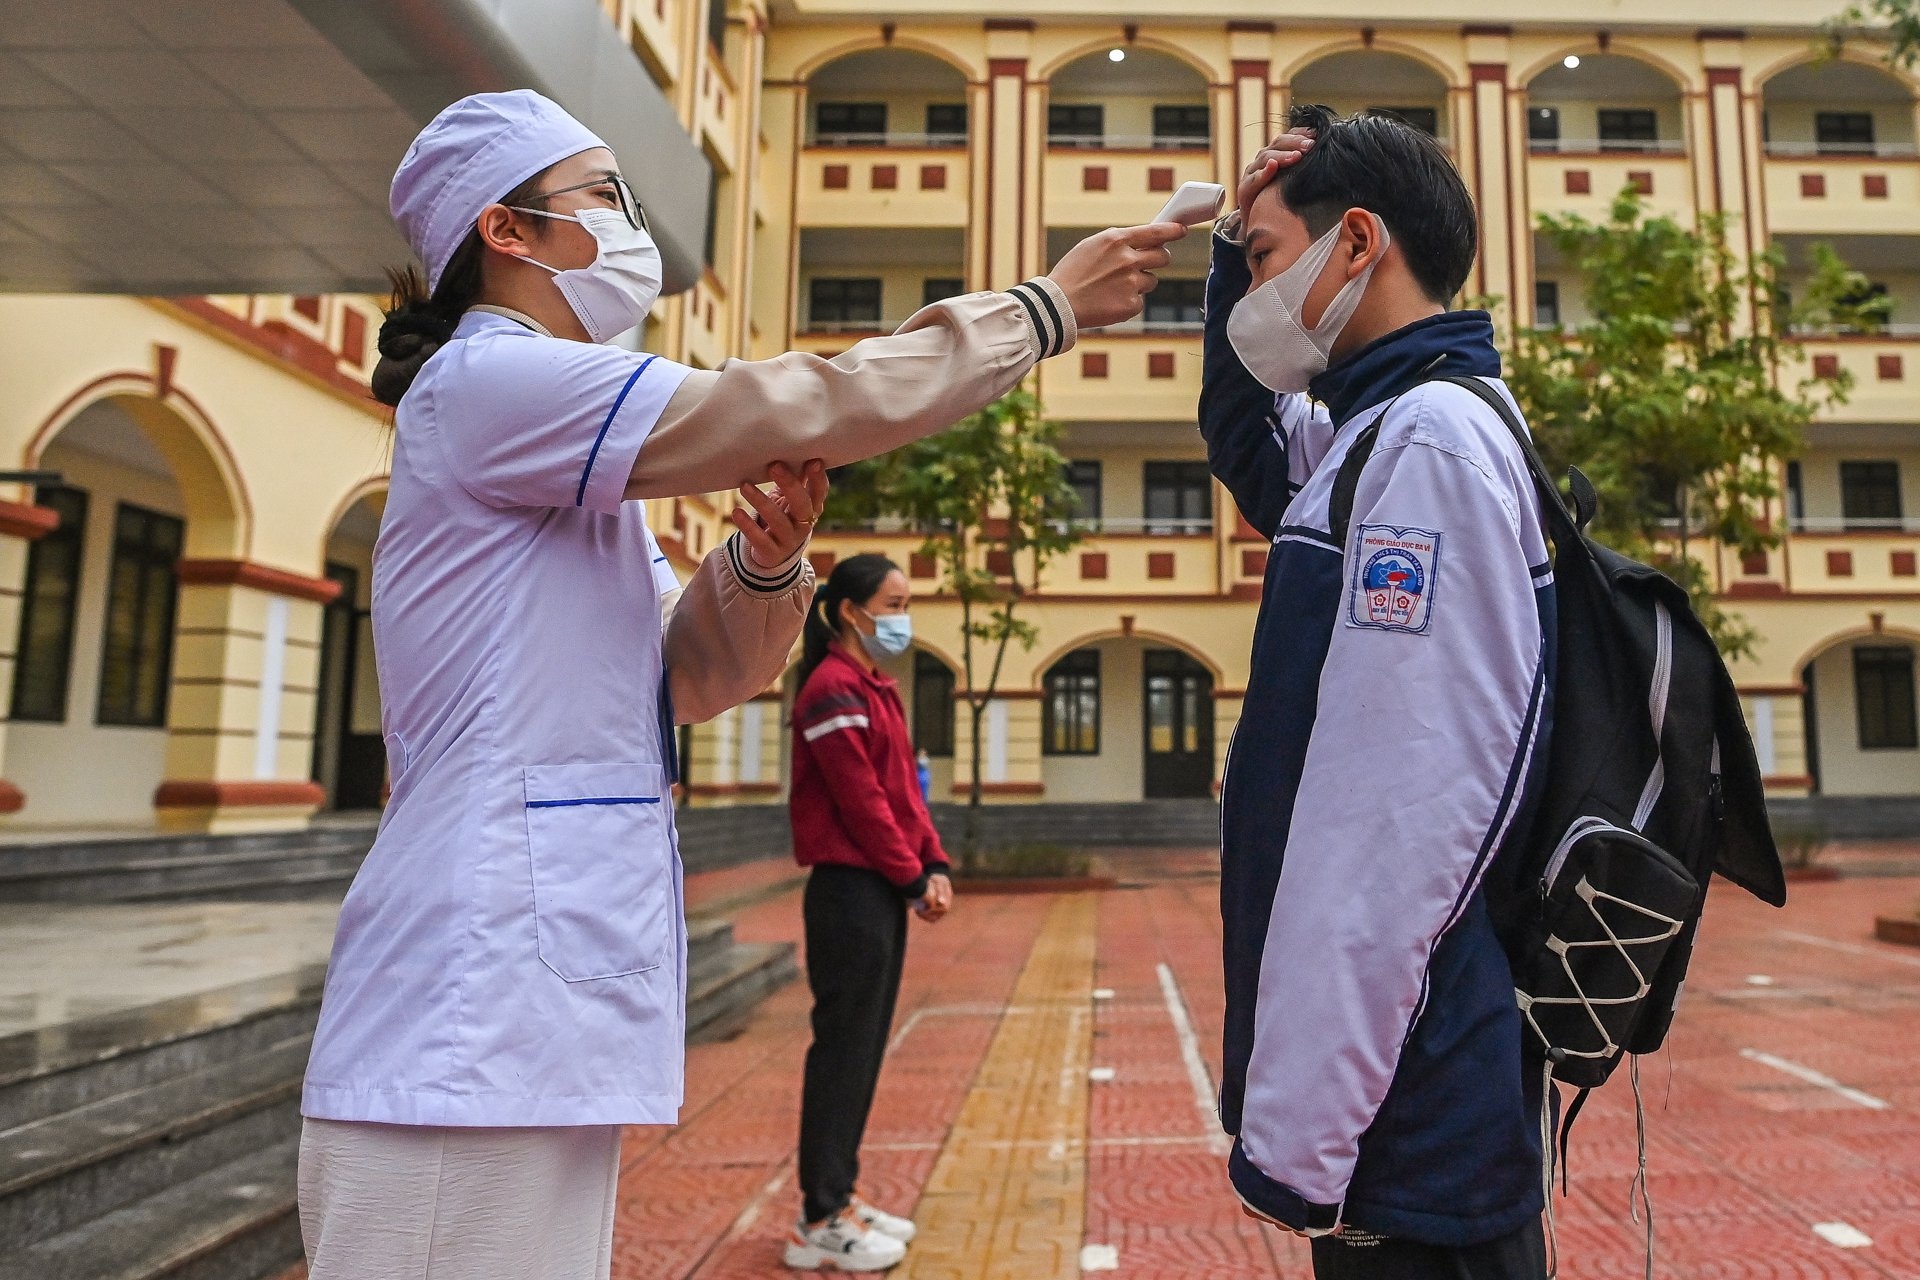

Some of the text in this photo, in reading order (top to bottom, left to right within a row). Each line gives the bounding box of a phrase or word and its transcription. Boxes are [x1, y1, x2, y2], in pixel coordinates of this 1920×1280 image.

[1365, 538, 1385, 546] PHÒNG
[1386, 539, 1401, 547] GIÁO
[1401, 542, 1415, 550] DỤC
[1376, 549, 1389, 559] THCS
